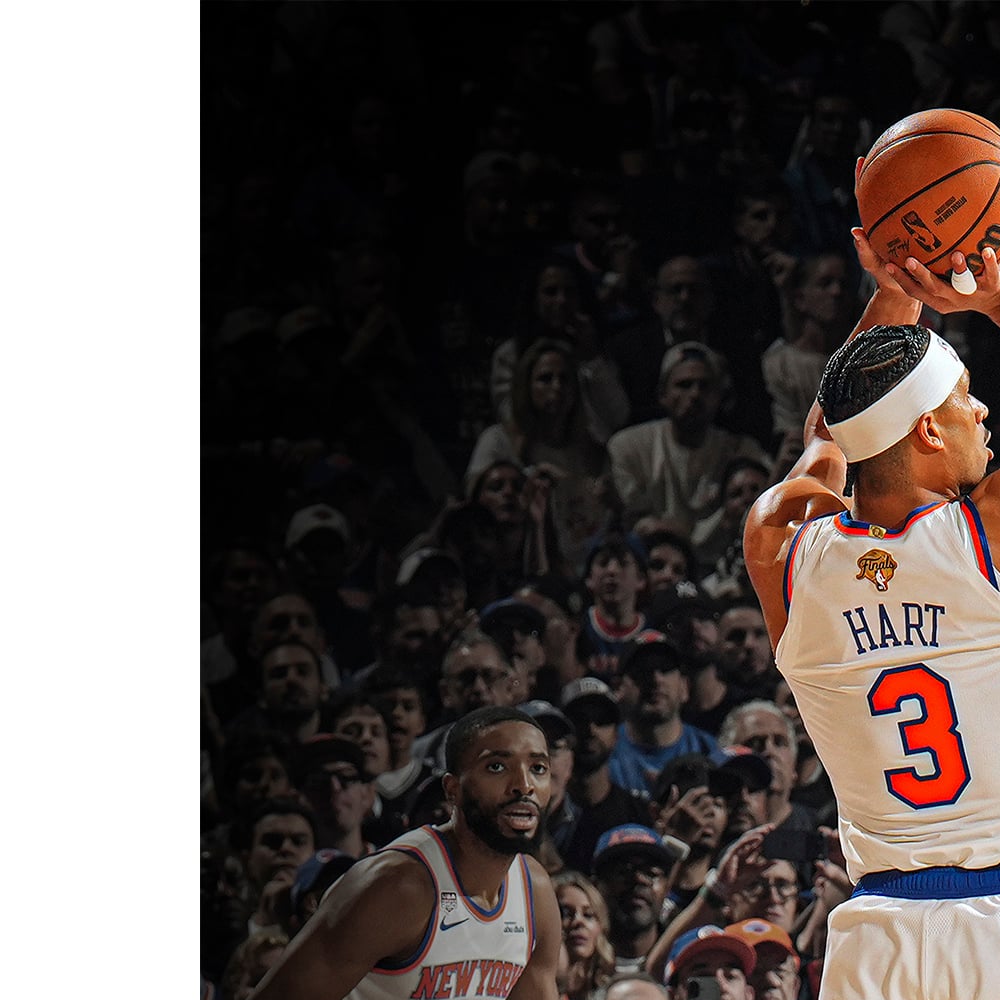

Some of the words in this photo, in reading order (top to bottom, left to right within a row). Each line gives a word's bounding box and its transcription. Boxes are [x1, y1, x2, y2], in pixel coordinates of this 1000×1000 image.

[859, 555, 896, 579] Finals
[843, 602, 946, 655] HART
[866, 662, 972, 811] 3
[410, 961, 480, 1000] NEW
